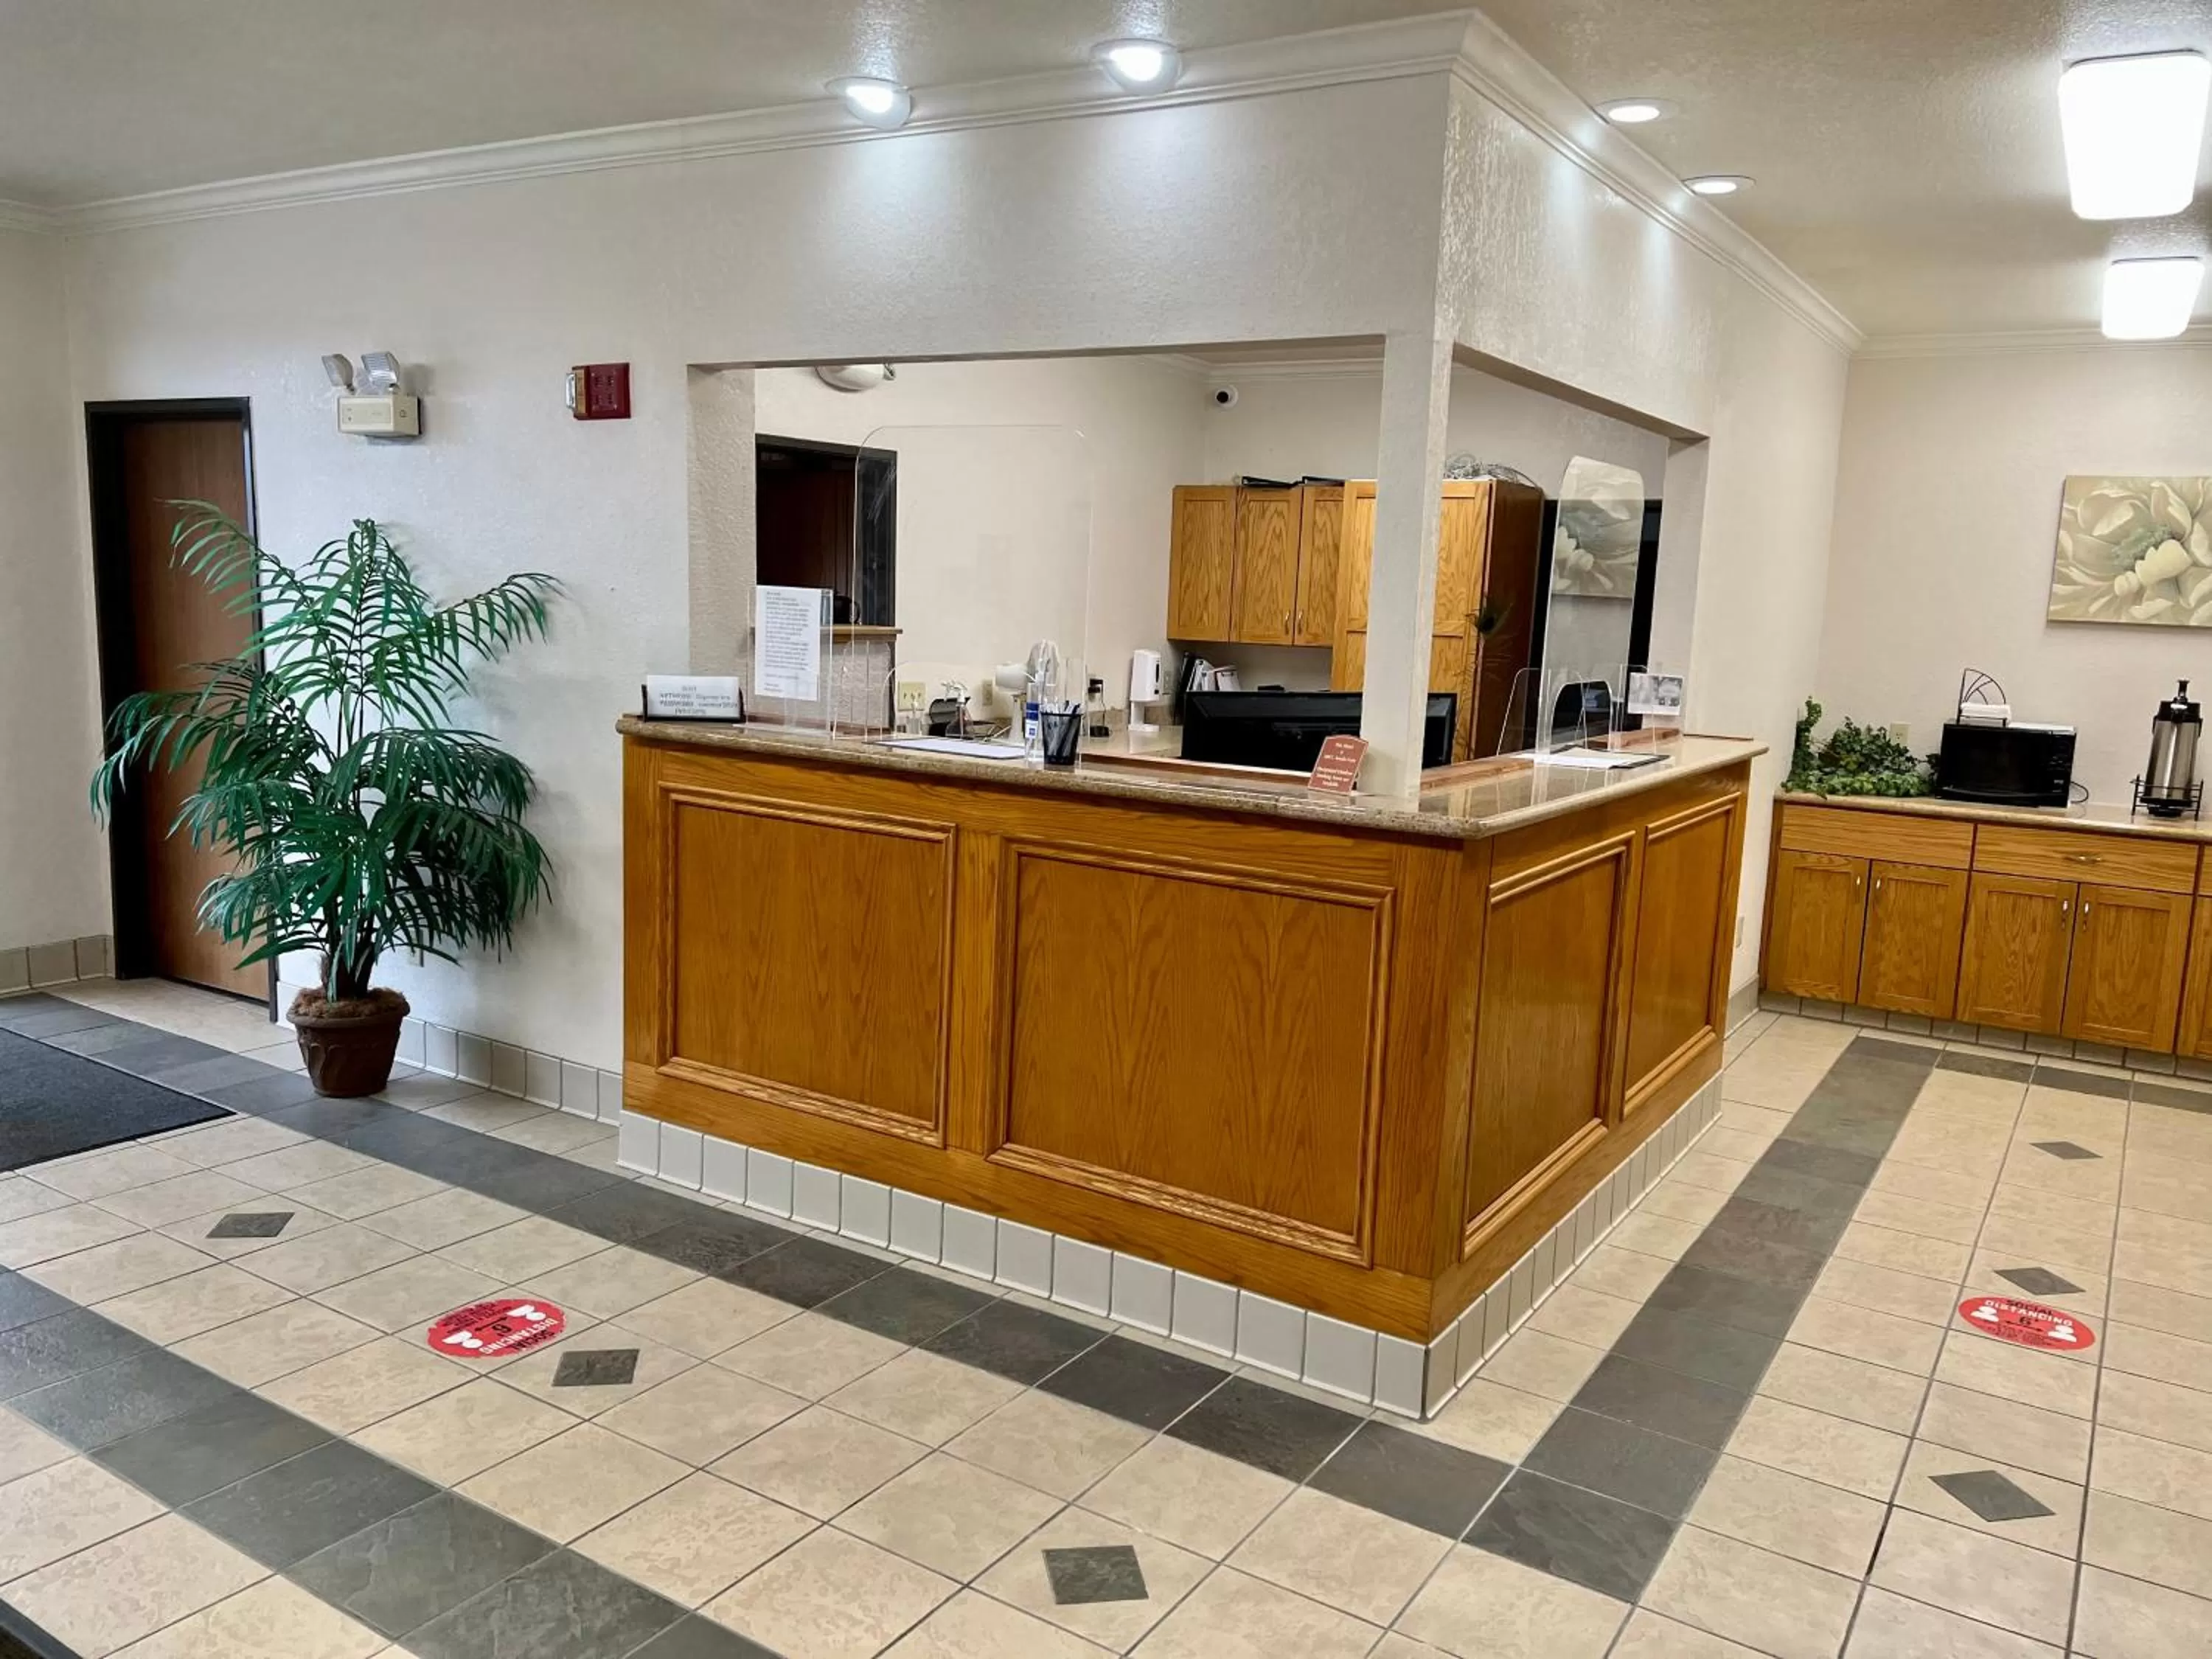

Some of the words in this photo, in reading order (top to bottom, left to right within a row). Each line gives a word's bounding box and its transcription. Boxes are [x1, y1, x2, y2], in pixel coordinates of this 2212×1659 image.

[1984, 1300, 2073, 1326] DISTANCING
[2006, 1299, 2053, 1315] SOCIAL
[479, 1318, 559, 1354] DISTANCING
